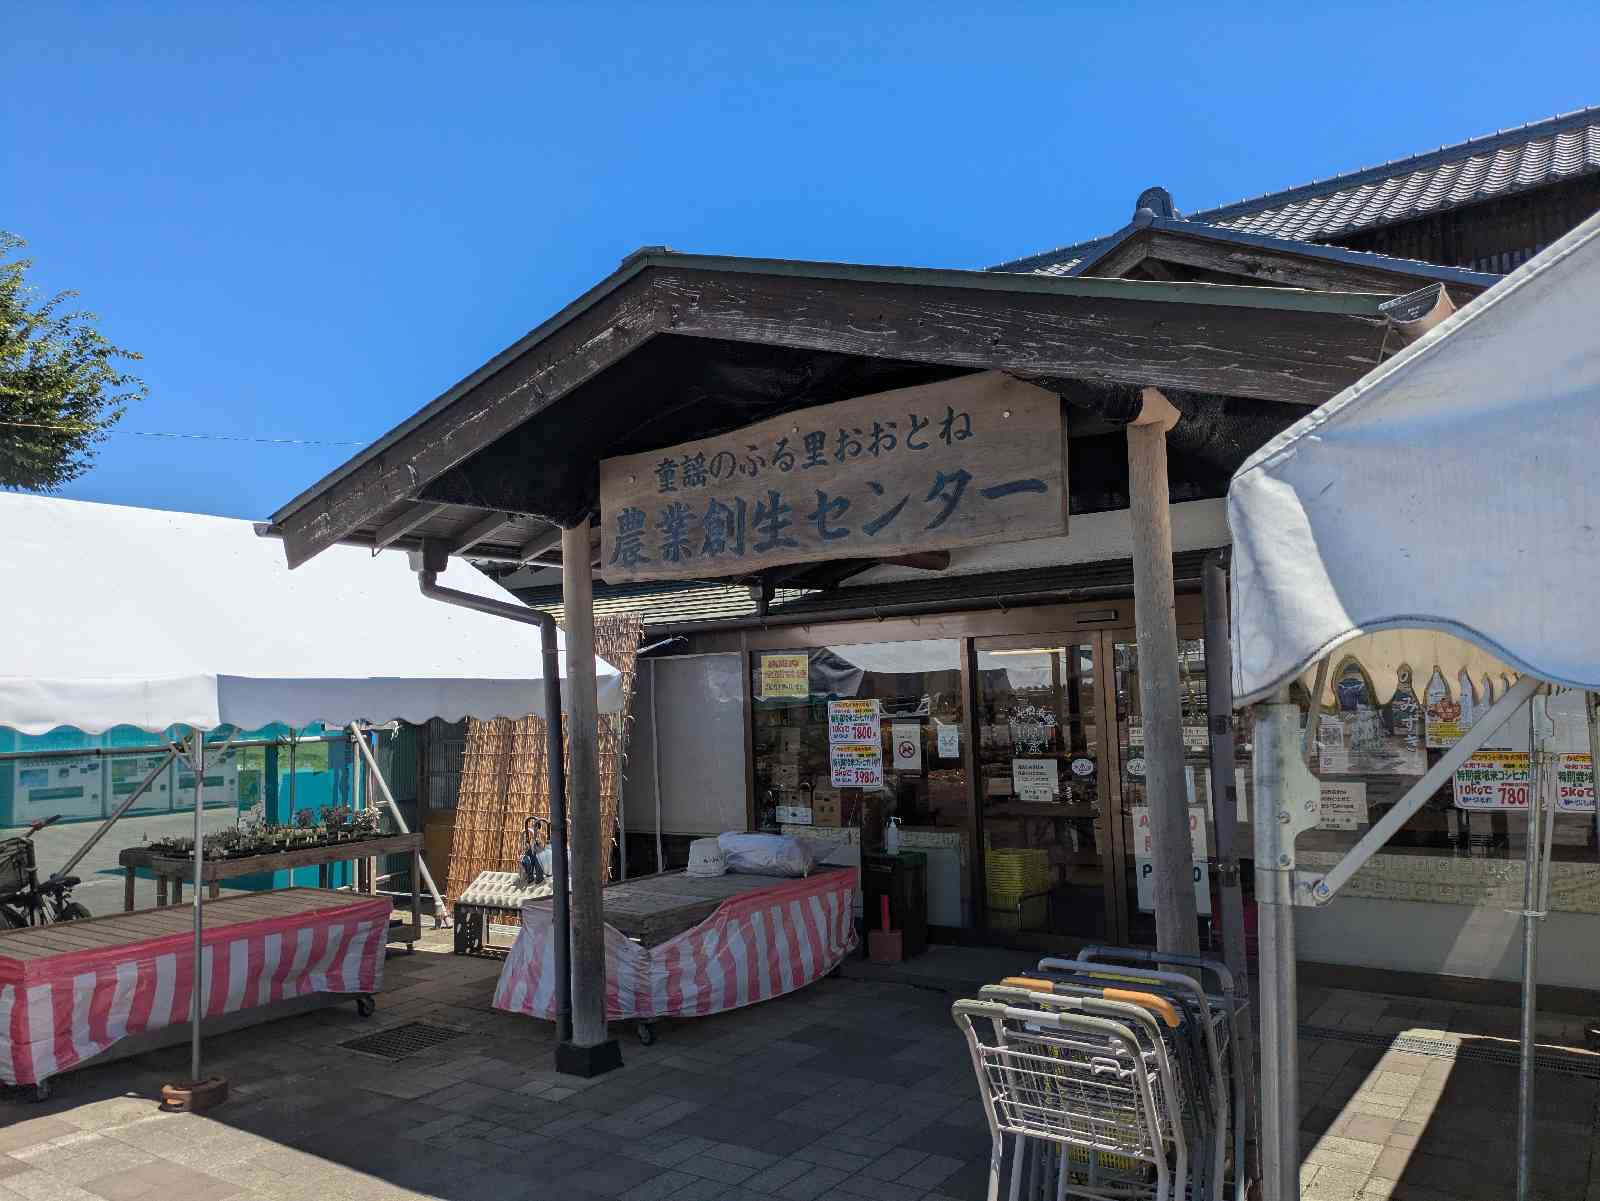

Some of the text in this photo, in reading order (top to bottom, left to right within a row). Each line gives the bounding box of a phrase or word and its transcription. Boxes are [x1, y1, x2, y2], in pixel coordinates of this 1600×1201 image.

[654, 405, 975, 494] 童謡のふる里おおとね
[609, 467, 1048, 566] 農業創生センター
[1457, 768, 1528, 781] 特別栽培米コシヒカ
[1498, 787, 1529, 805] 780
